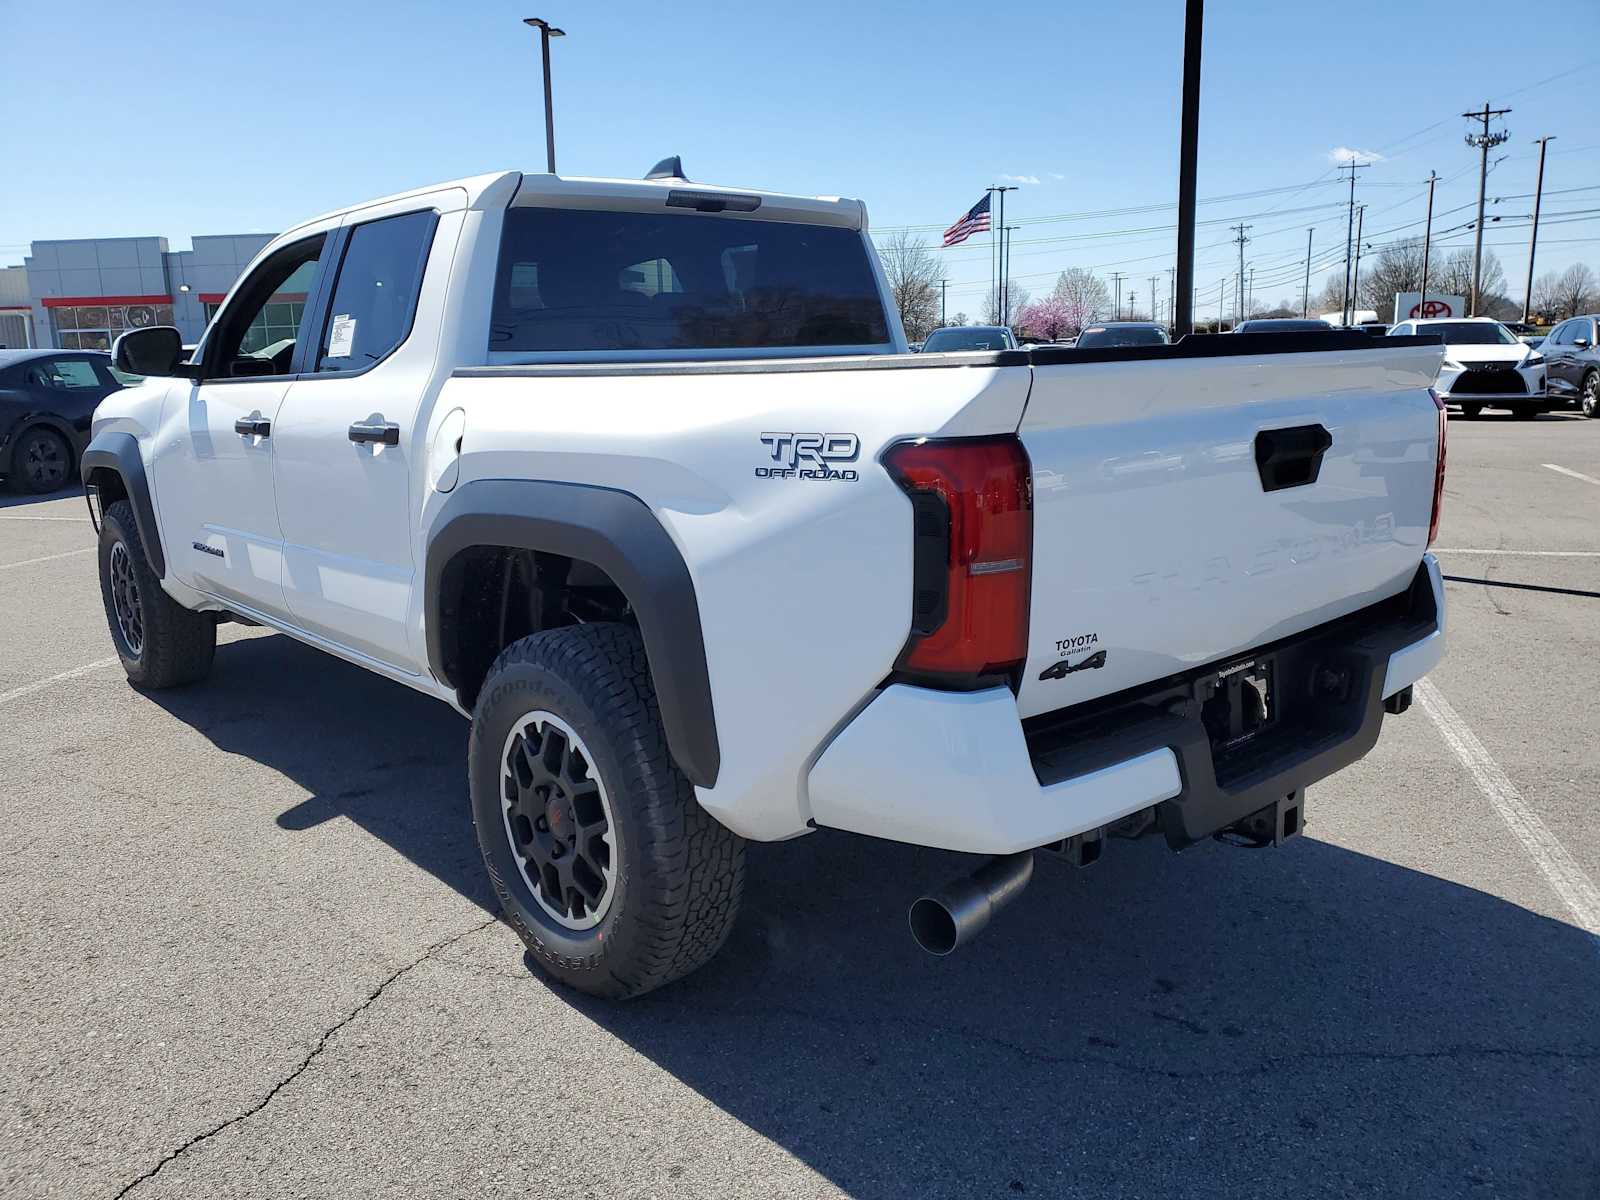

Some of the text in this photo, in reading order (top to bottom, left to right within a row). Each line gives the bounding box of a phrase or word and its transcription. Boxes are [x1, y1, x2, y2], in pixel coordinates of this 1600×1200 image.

[760, 432, 861, 470] TRD
[755, 467, 859, 481] OFF ROAD
[1055, 633, 1098, 651] TOYOTA
[1060, 646, 1091, 657] Gallatin
